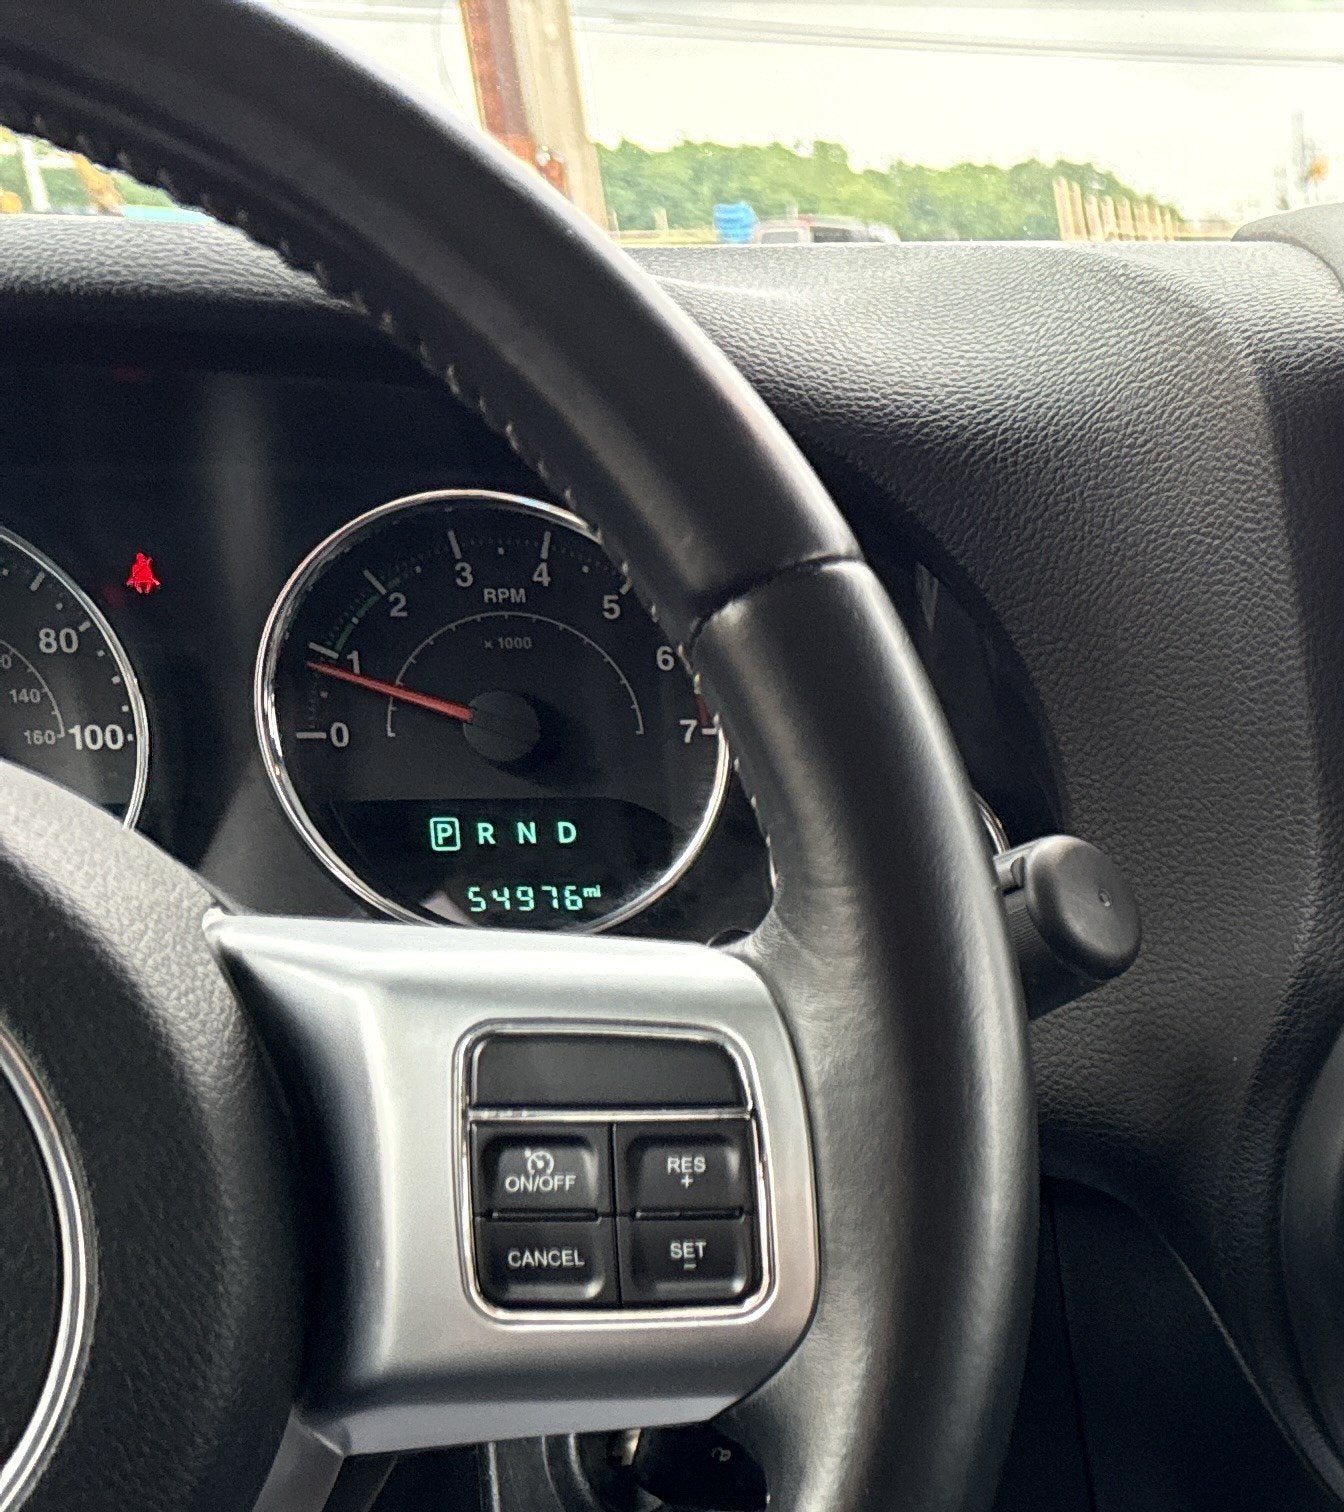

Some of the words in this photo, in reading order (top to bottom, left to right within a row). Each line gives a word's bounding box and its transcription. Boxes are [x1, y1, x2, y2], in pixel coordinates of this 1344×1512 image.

[455, 562, 473, 587] 3
[532, 564, 550, 587] 4
[389, 592, 407, 617] 2
[484, 588, 526, 604] RPM
[602, 595, 621, 620] 5
[39, 628, 79, 653] 80
[498, 636, 532, 650] 1000
[346, 651, 361, 675] 1
[655, 646, 674, 671] 6
[9, 688, 41, 703] 140
[23, 730, 56, 745] 160
[68, 724, 124, 750] 100
[330, 722, 350, 747] 0
[679, 720, 698, 743] 7
[437, 823, 453, 845] P
[477, 822, 496, 844] R
[516, 821, 537, 844] N
[557, 821, 577, 843] D
[467, 885, 583, 912] 54976
[667, 1156, 706, 1174] RES
[505, 1175, 577, 1193] ON/OFF
[507, 1249, 585, 1268] CANCEL
[670, 1241, 706, 1260] SET
